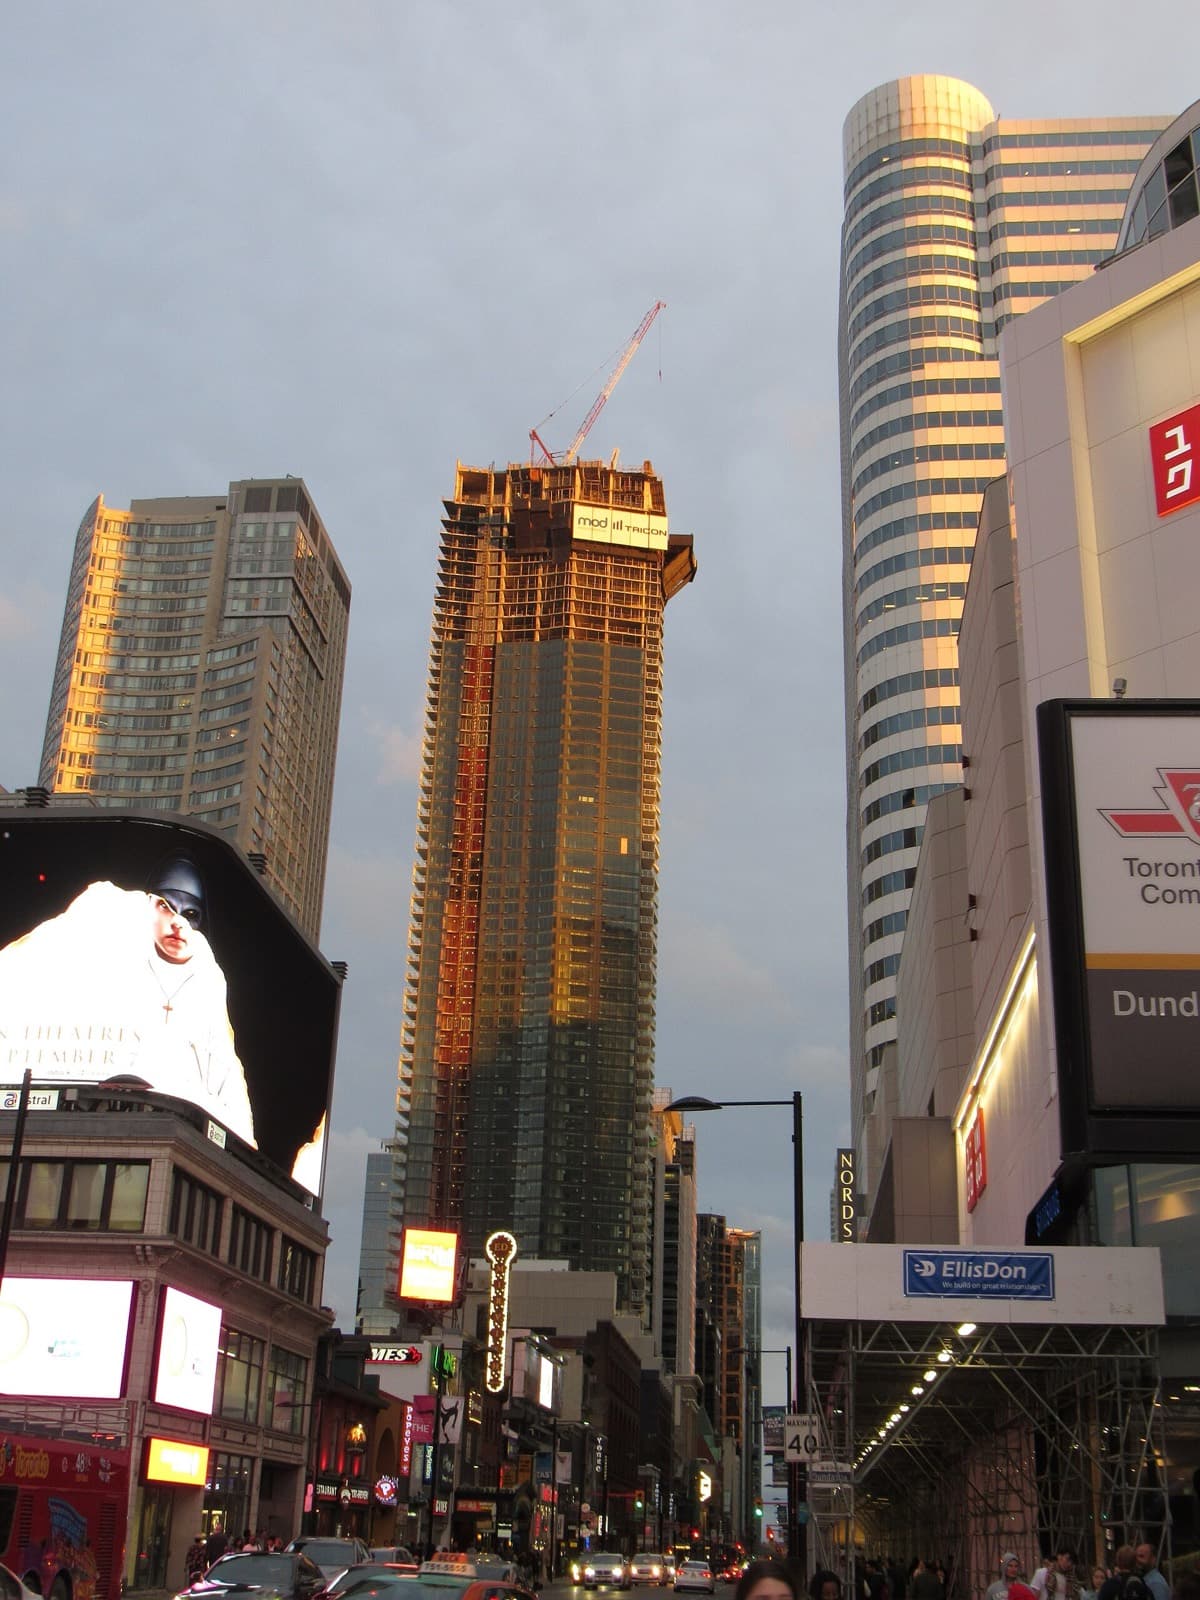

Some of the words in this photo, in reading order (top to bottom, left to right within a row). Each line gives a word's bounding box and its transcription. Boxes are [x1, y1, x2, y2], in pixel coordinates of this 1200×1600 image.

[624, 525, 667, 537] TRICON
[1112, 990, 1199, 1017] Dund
[840, 1153, 854, 1243] NORDS
[942, 1261, 1027, 1279] EllisDon
[788, 1434, 817, 1455] 40
